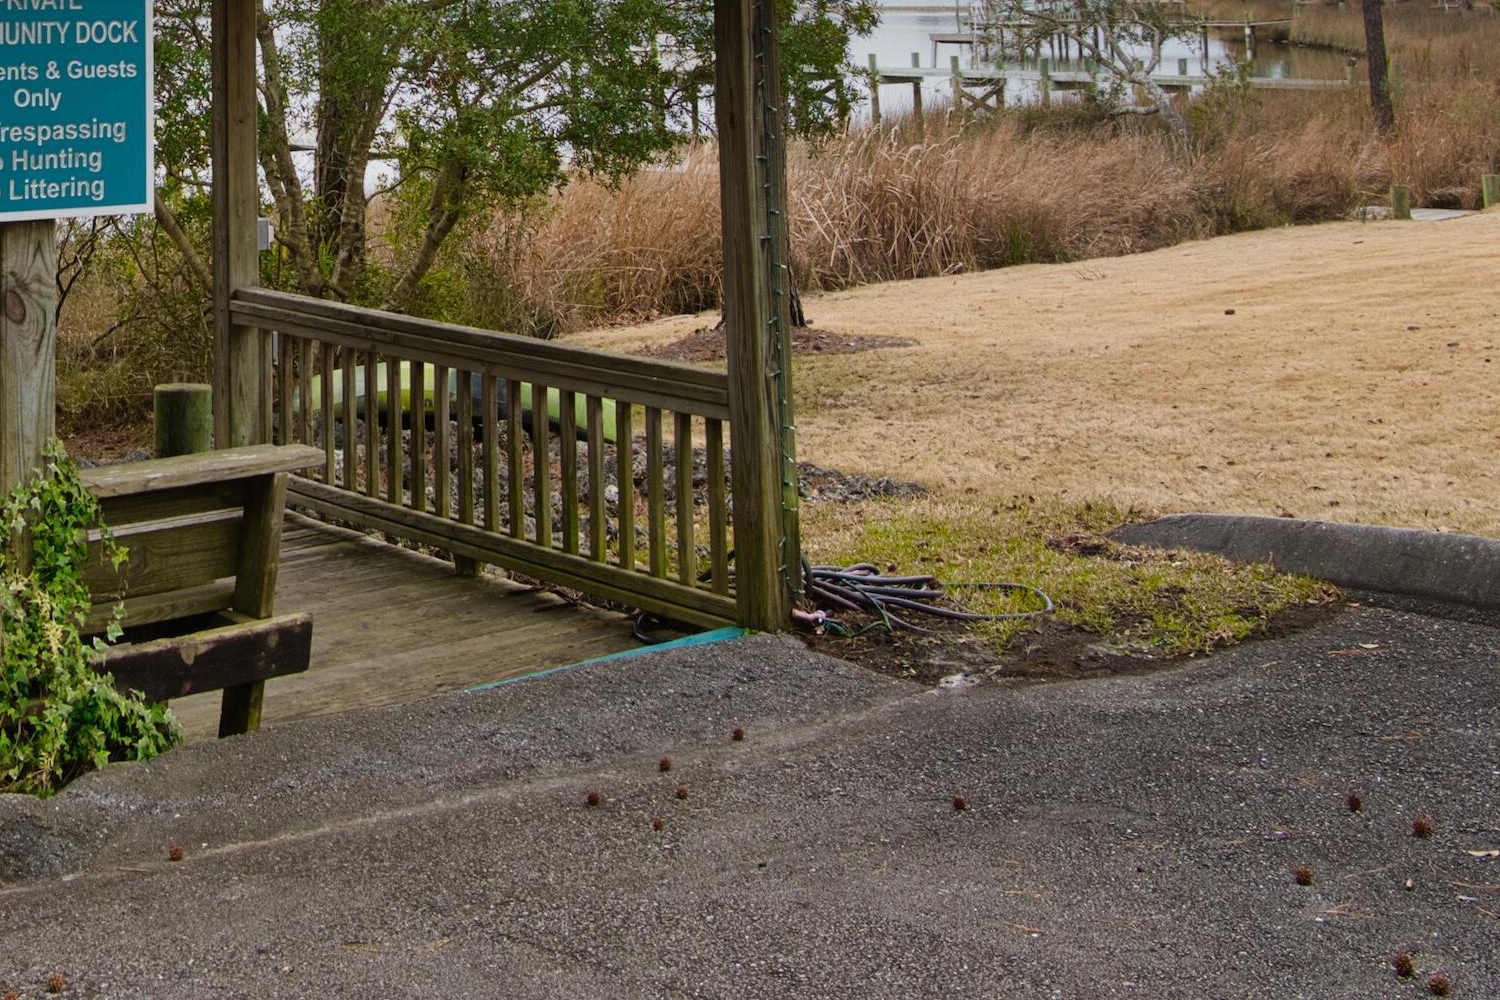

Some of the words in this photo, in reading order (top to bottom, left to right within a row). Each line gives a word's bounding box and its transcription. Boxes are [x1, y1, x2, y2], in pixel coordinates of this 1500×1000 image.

[75, 20, 138, 44] DOCK
[46, 61, 61, 80] &
[67, 60, 137, 79] Guests
[13, 87, 62, 111] Only
[11, 148, 103, 173] Hunting
[9, 177, 105, 201] Littering
